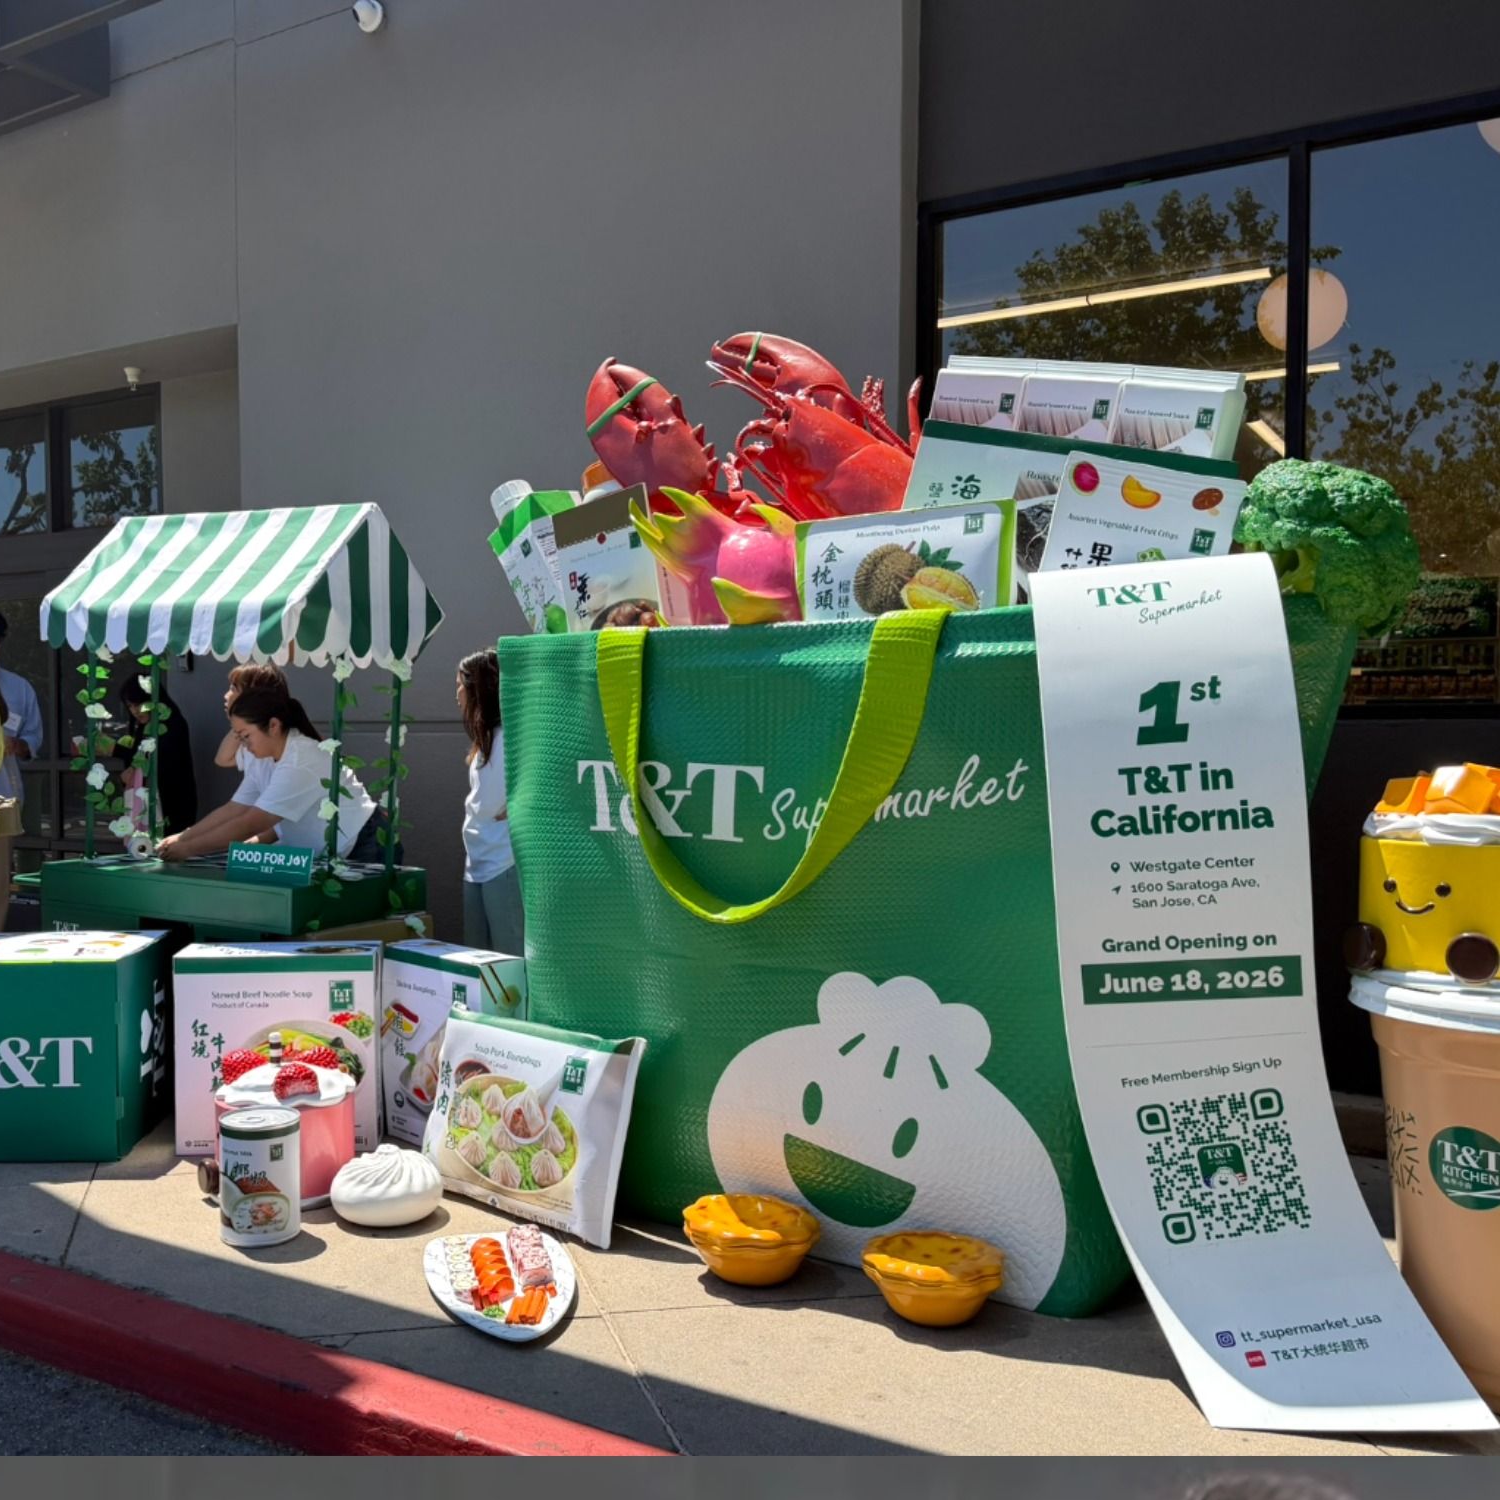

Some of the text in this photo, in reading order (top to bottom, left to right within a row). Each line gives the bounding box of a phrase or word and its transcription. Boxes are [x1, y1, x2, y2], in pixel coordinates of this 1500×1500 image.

[951, 474, 981, 499] 海
[1026, 470, 1060, 482] Roaste
[1067, 513, 1097, 525] Assorted
[1098, 518, 1132, 532] Vegetable
[1140, 526, 1157, 536] Fruit
[1157, 530, 1179, 540] Crisps
[1087, 581, 1172, 607] T&T
[1139, 588, 1222, 625] Supermarket
[1136, 675, 1222, 746] 1st
[1118, 761, 1234, 796] T&T in
[762, 753, 1029, 849] Supmarket
[1090, 799, 1275, 838] California
[232, 849, 309, 868] FOOD FOR JOY
[1129, 856, 1256, 874] Westgate Center
[1130, 882, 1164, 894] 1600
[1166, 877, 1229, 892] Saratoga
[1132, 898, 1157, 909] San
[1197, 894, 1218, 906] CA
[53, 920, 80, 933] T&T
[1101, 933, 1278, 954] Grand Opening on
[1099, 966, 1286, 995] June 18, 2026
[211, 989, 313, 1000] Stewed Beef Noodle Soup
[211, 1001, 236, 1009] Product
[245, 1001, 270, 1009] Canada
[564, 1064, 587, 1079] T&T
[1120, 1057, 1282, 1089] Free Membership Sign Up
[1203, 1146, 1235, 1161] T&T
[1437, 1139, 1500, 1173] T&T
[1441, 1163, 1500, 1187] KITCHEN
[1240, 1313, 1382, 1343] tt_supermarket_usa
